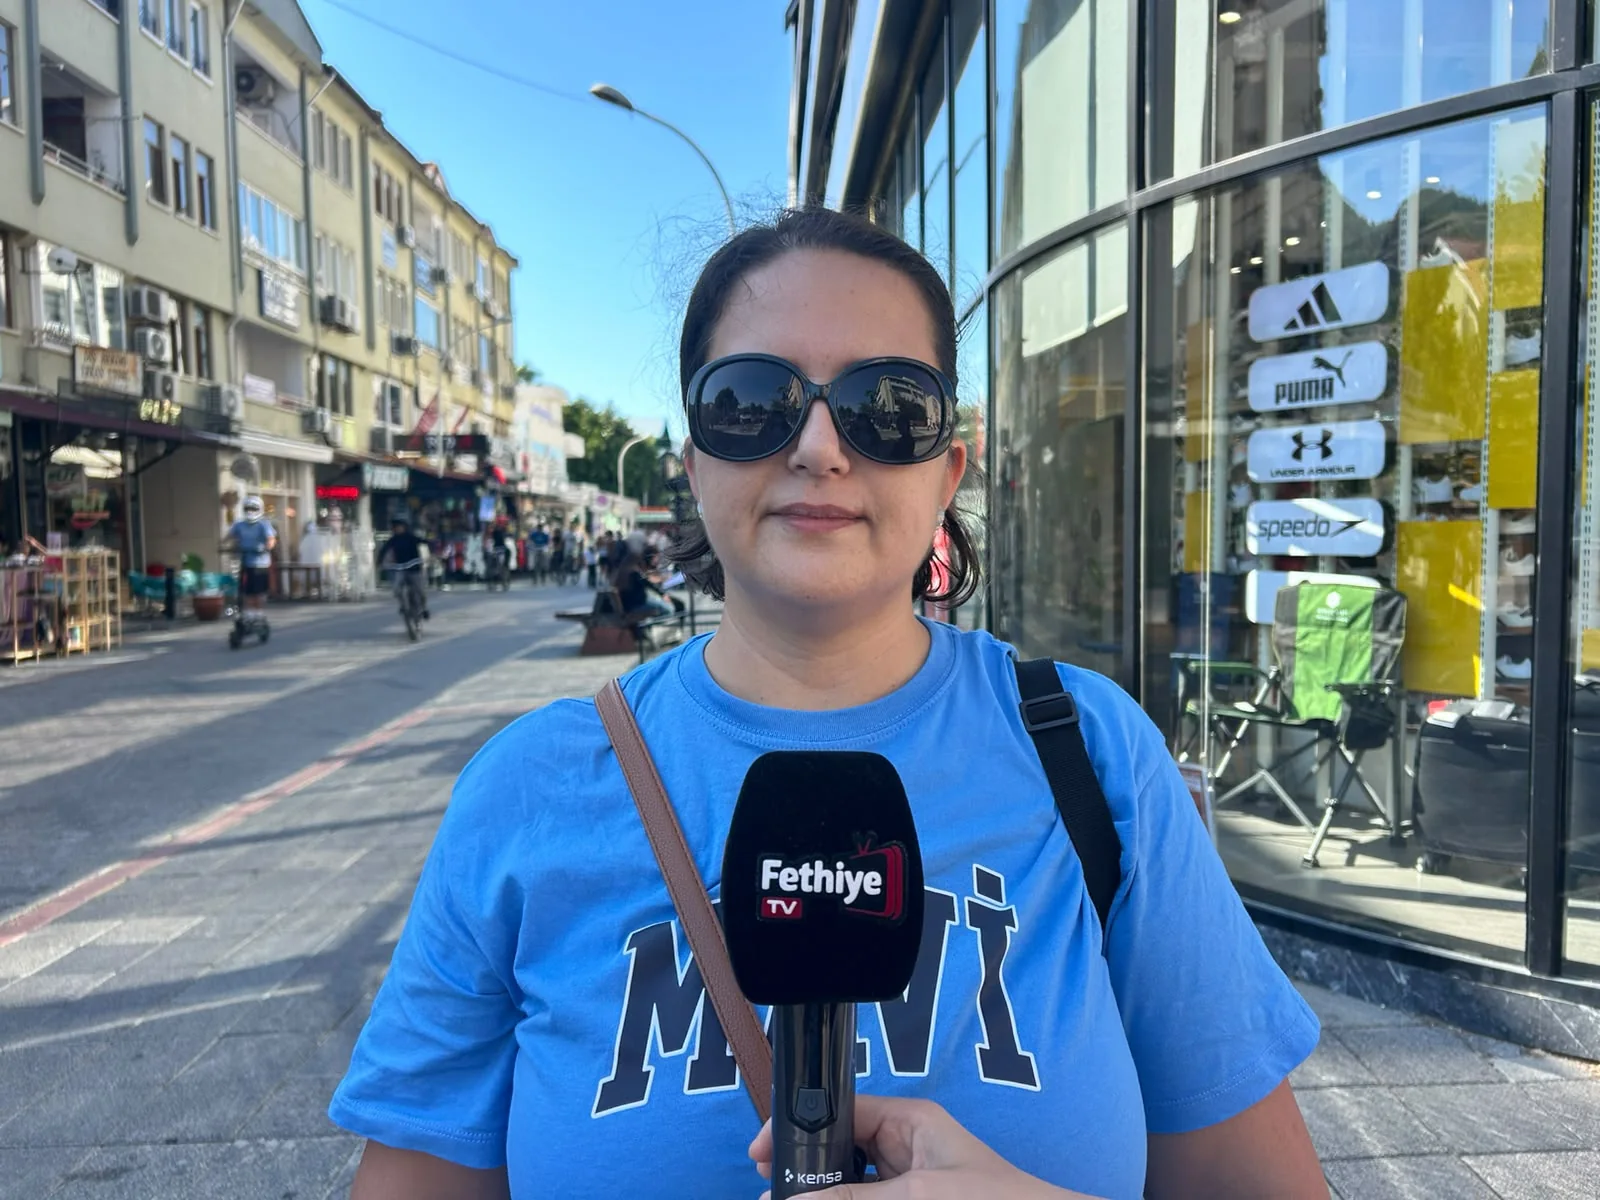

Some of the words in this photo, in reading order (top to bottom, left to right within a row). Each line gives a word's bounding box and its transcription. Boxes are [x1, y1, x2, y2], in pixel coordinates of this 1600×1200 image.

[1275, 377, 1335, 405] PUMA
[1270, 468, 1305, 478] UNDER
[1307, 464, 1356, 476] ARMOUR
[1257, 515, 1331, 542] speedo
[761, 859, 882, 905] Fethiye
[766, 899, 798, 915] TV
[797, 1170, 843, 1185] kensa
